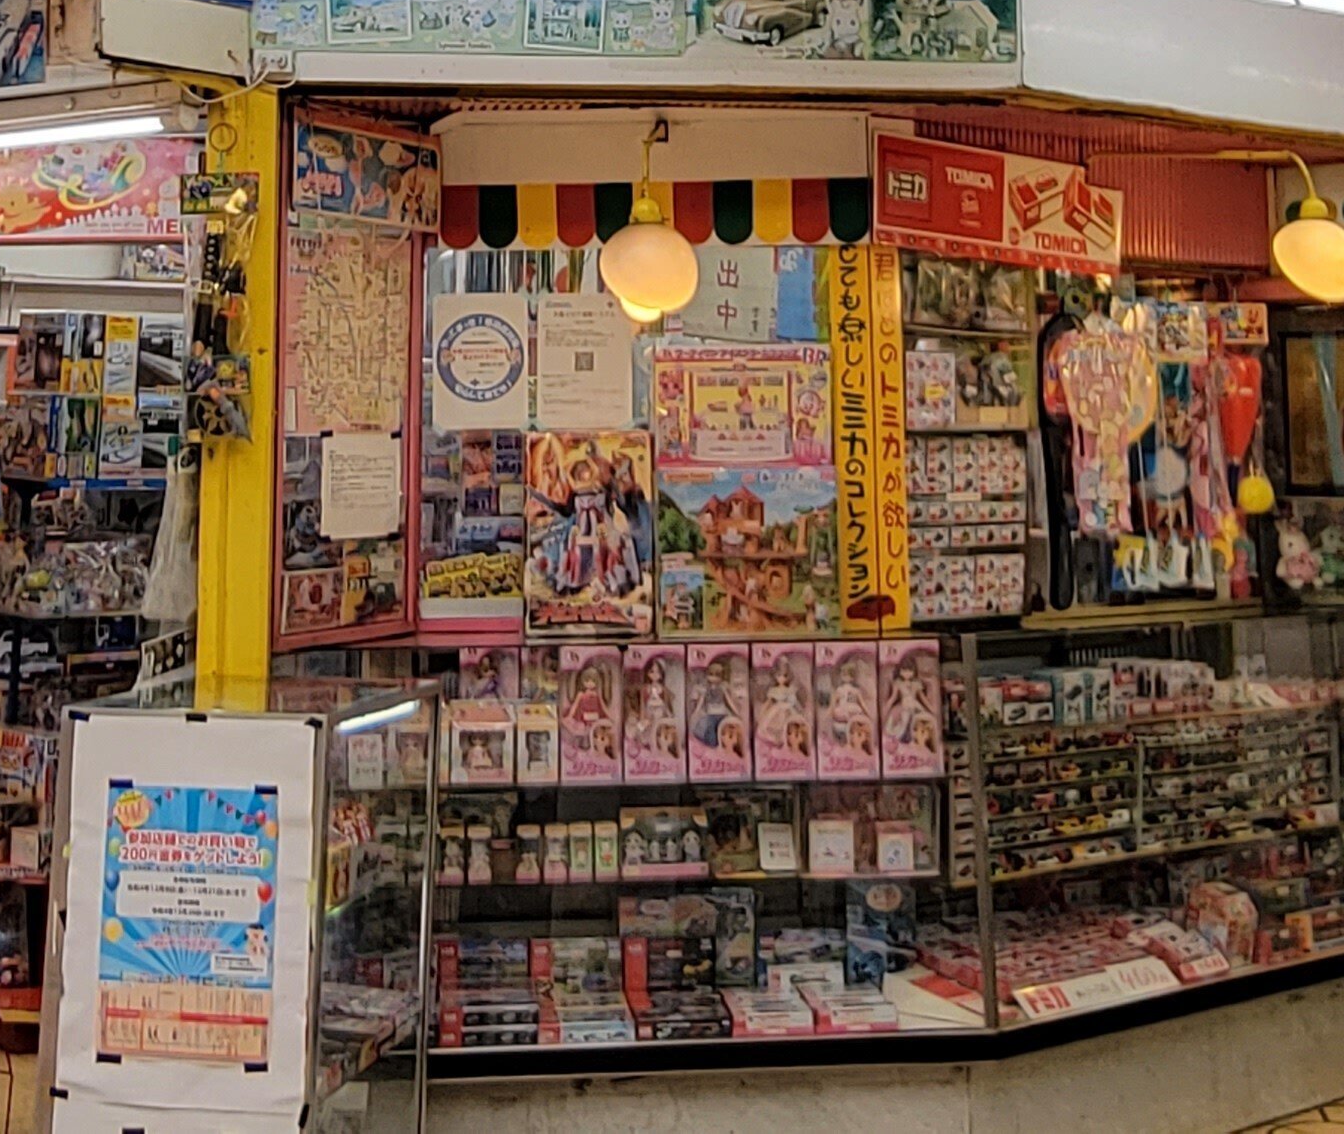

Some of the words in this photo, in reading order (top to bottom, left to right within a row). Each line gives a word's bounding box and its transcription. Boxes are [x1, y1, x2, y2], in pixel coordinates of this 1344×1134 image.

[886, 170, 928, 202] トミカ
[945, 166, 995, 191] TOMICA
[1033, 231, 1089, 256] TOMICA
